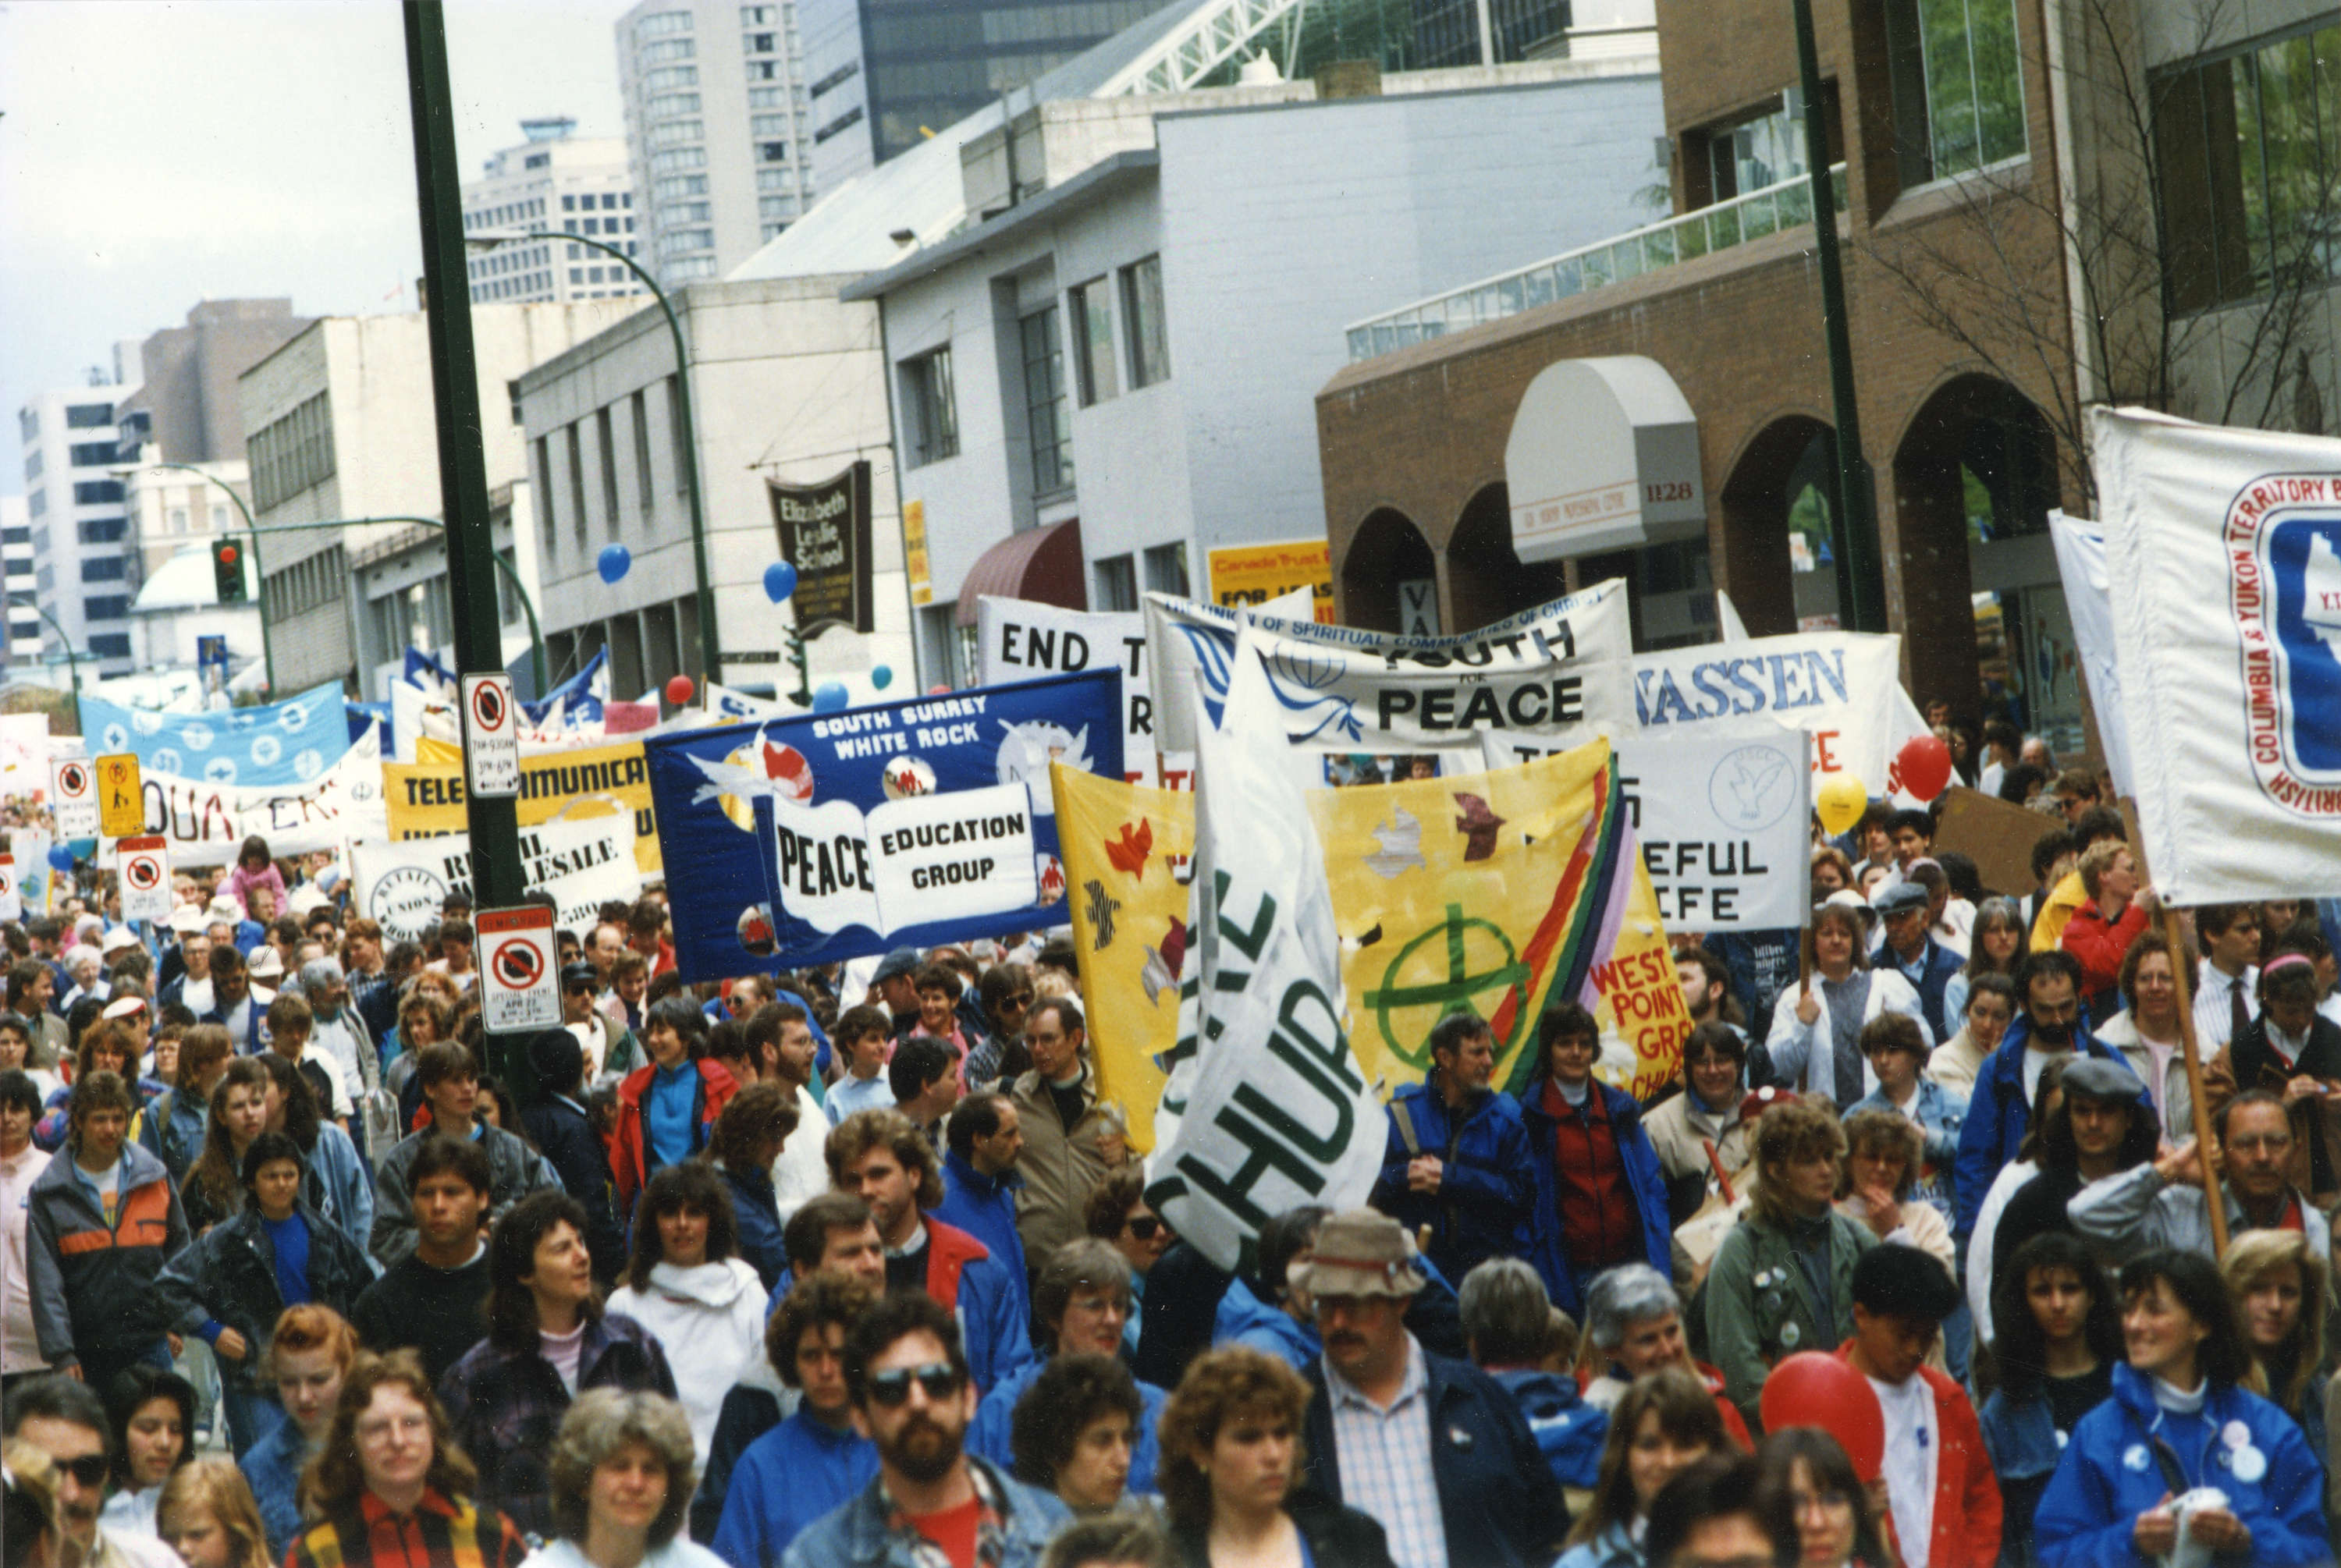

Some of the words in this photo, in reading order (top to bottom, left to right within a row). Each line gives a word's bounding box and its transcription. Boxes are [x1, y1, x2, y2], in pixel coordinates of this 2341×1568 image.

[780, 490, 847, 522] Elizabeth
[1647, 481, 1693, 503] 1128
[2229, 479, 2325, 542] TERRITORY
[795, 540, 844, 571] School
[1215, 556, 1277, 573] Canada
[1278, 553, 1320, 566] Trust
[1221, 588, 1267, 605] FOR
[2234, 550, 2261, 622] YUKON
[1002, 623, 1089, 672] END
[1263, 616, 1286, 631] OF
[1292, 623, 1385, 647] SPIRITUAL
[1394, 619, 1512, 649] COMMUNITIES
[1519, 608, 1537, 625] OF
[1361, 619, 1575, 669] YOUTH
[2244, 630, 2265, 642] &
[812, 711, 892, 738] SOUTH
[901, 694, 987, 725] SURREY
[1378, 676, 1583, 730] PEACE
[2248, 648, 2279, 764] COLUMBIA
[834, 731, 909, 761] WHITE
[916, 721, 980, 749] ROCK
[880, 813, 1025, 856] EDUCATION
[777, 824, 875, 896] PEACE
[911, 857, 995, 889] GROUP
[1642, 840, 1768, 876] EFUL
[388, 896, 431, 915] UNION
[1654, 886, 1739, 921] IFE
[1590, 946, 1668, 996] WEST
[1612, 984, 1686, 1027] POINT
